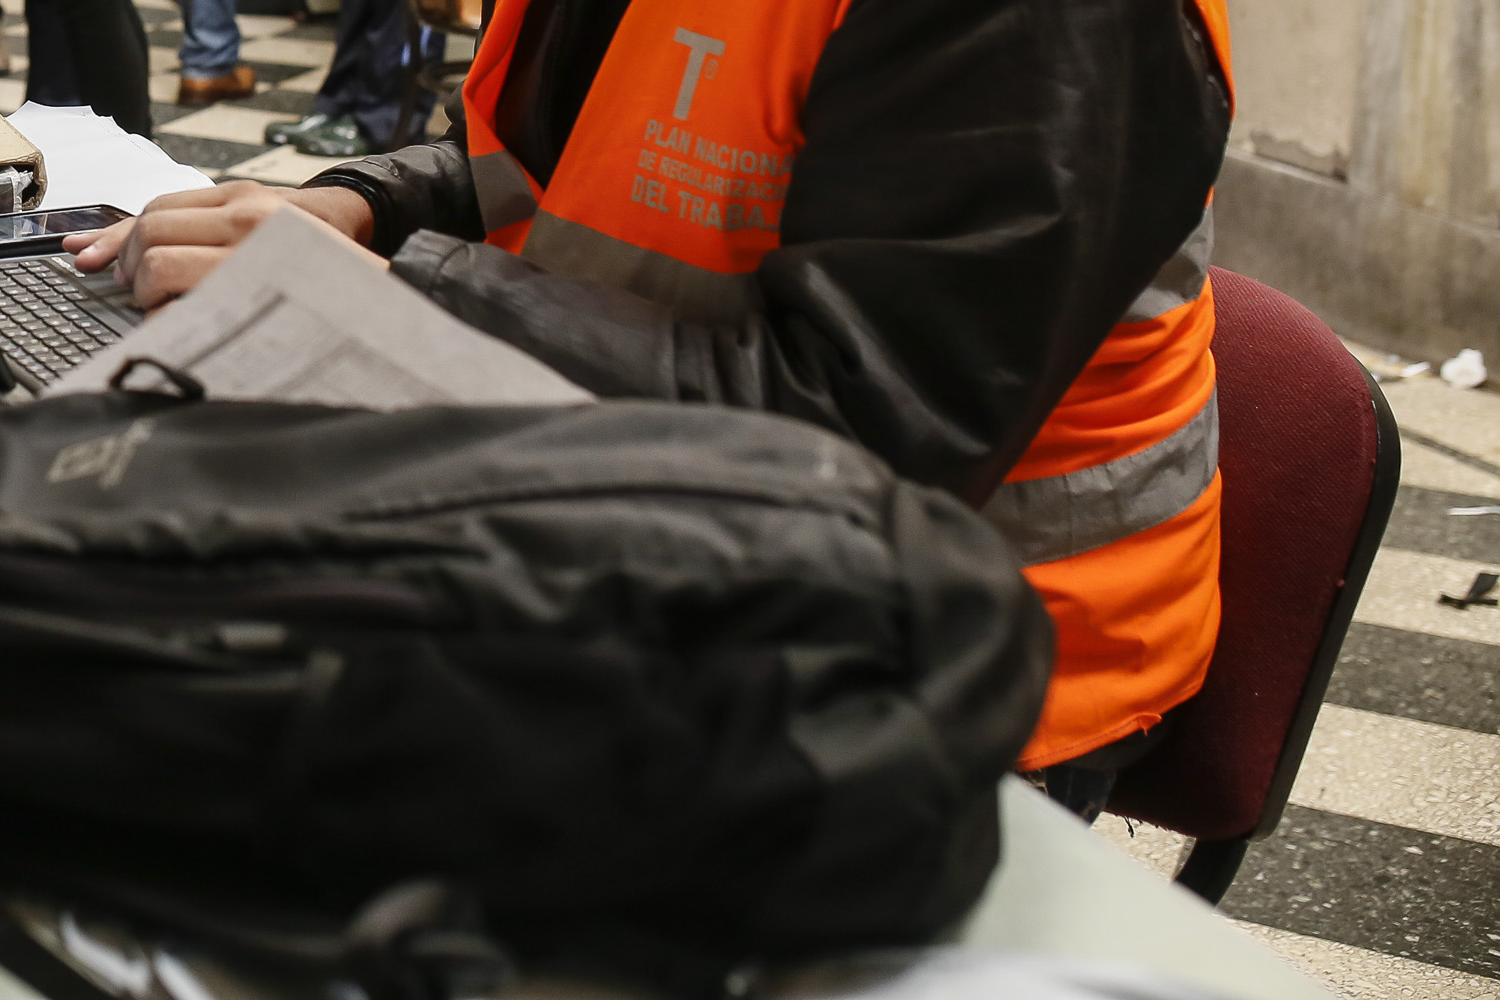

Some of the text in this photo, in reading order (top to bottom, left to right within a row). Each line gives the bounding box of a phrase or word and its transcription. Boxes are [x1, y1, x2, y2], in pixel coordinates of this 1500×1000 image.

[637, 149, 790, 202] DE REGULARIZACI
[644, 119, 794, 178] PLAN NACIONA
[631, 174, 782, 233] DEL TRABAJ
